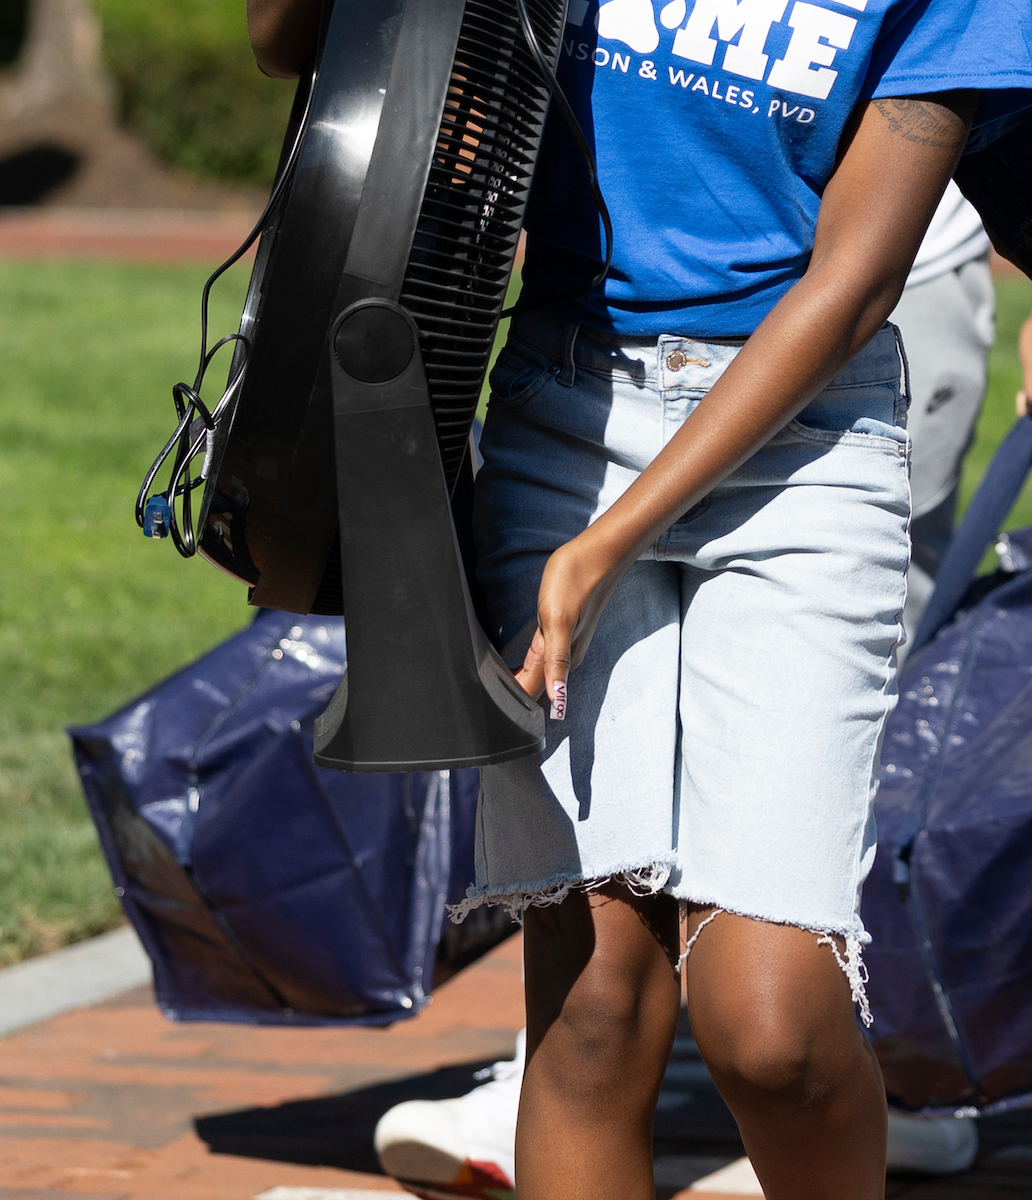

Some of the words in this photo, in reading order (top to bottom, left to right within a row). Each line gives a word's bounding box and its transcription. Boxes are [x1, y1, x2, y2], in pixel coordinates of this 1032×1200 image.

[638, 60, 657, 80] &
[668, 66, 760, 114] WALES,
[767, 99, 815, 123] PVD
